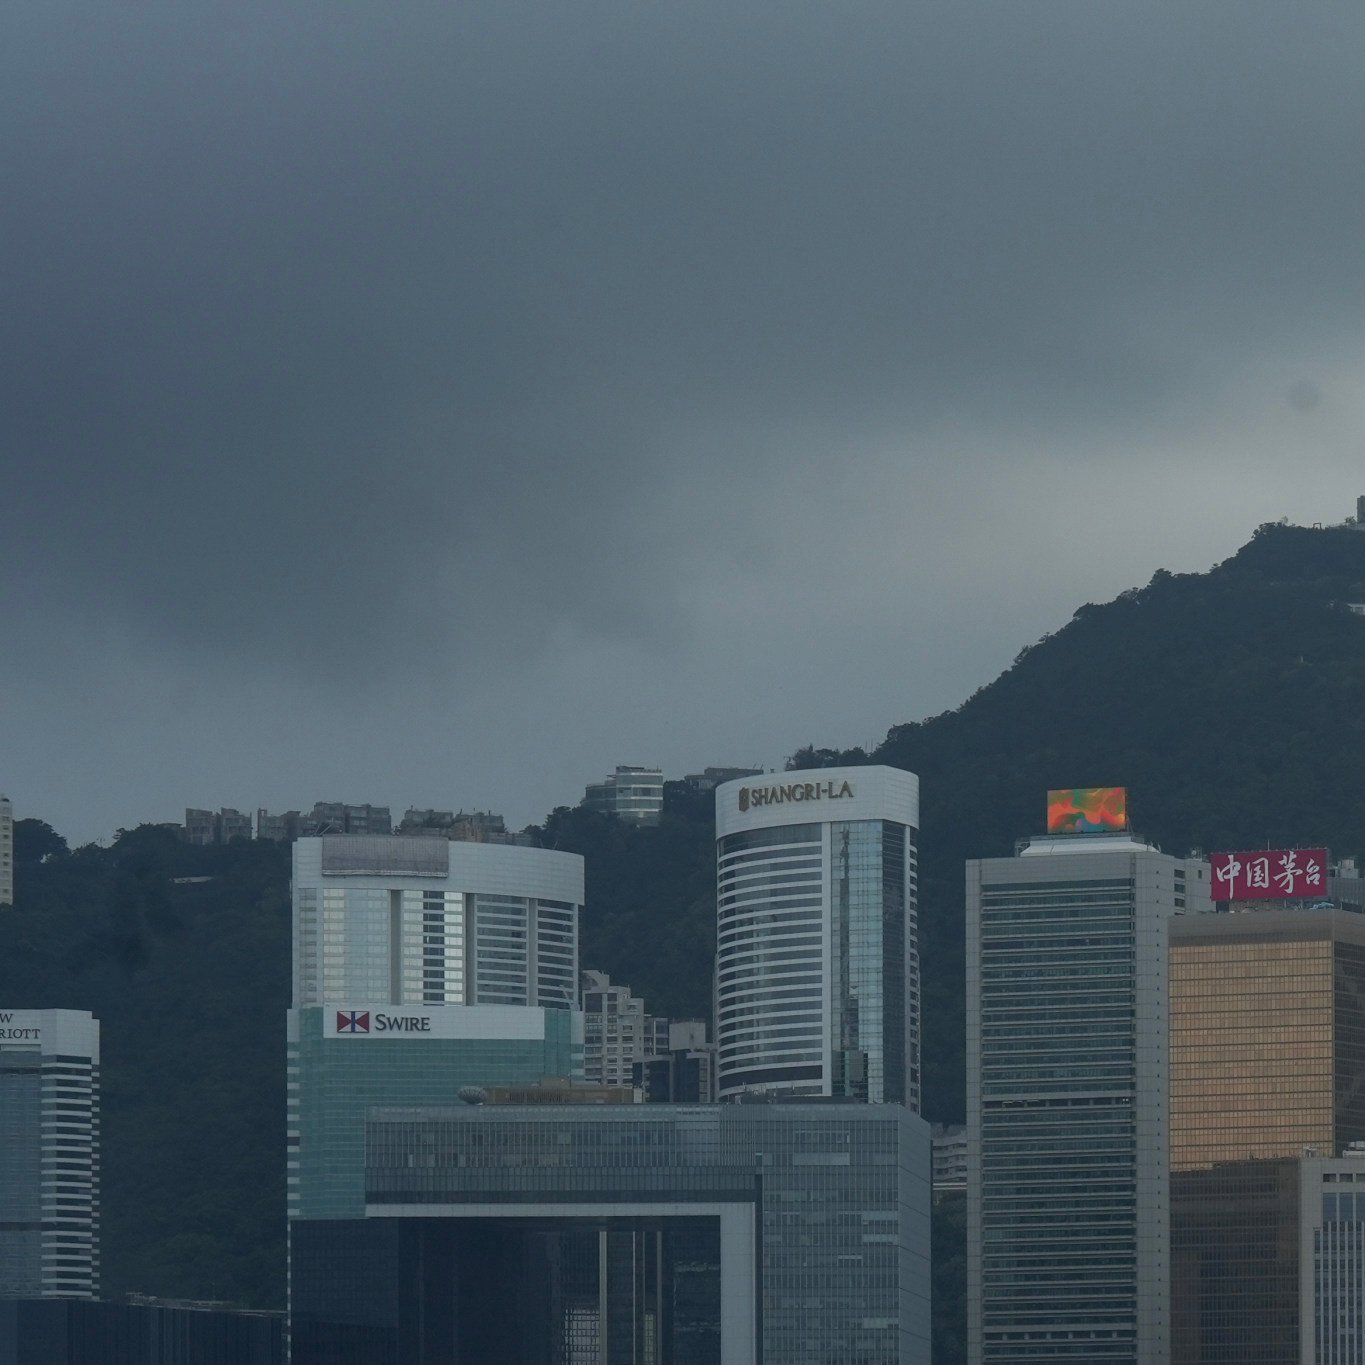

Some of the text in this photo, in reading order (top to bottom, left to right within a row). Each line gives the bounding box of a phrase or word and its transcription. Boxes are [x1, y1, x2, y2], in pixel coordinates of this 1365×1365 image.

[750, 780, 854, 808] SHANGRI-LA
[1216, 850, 1321, 900] 中国茅台
